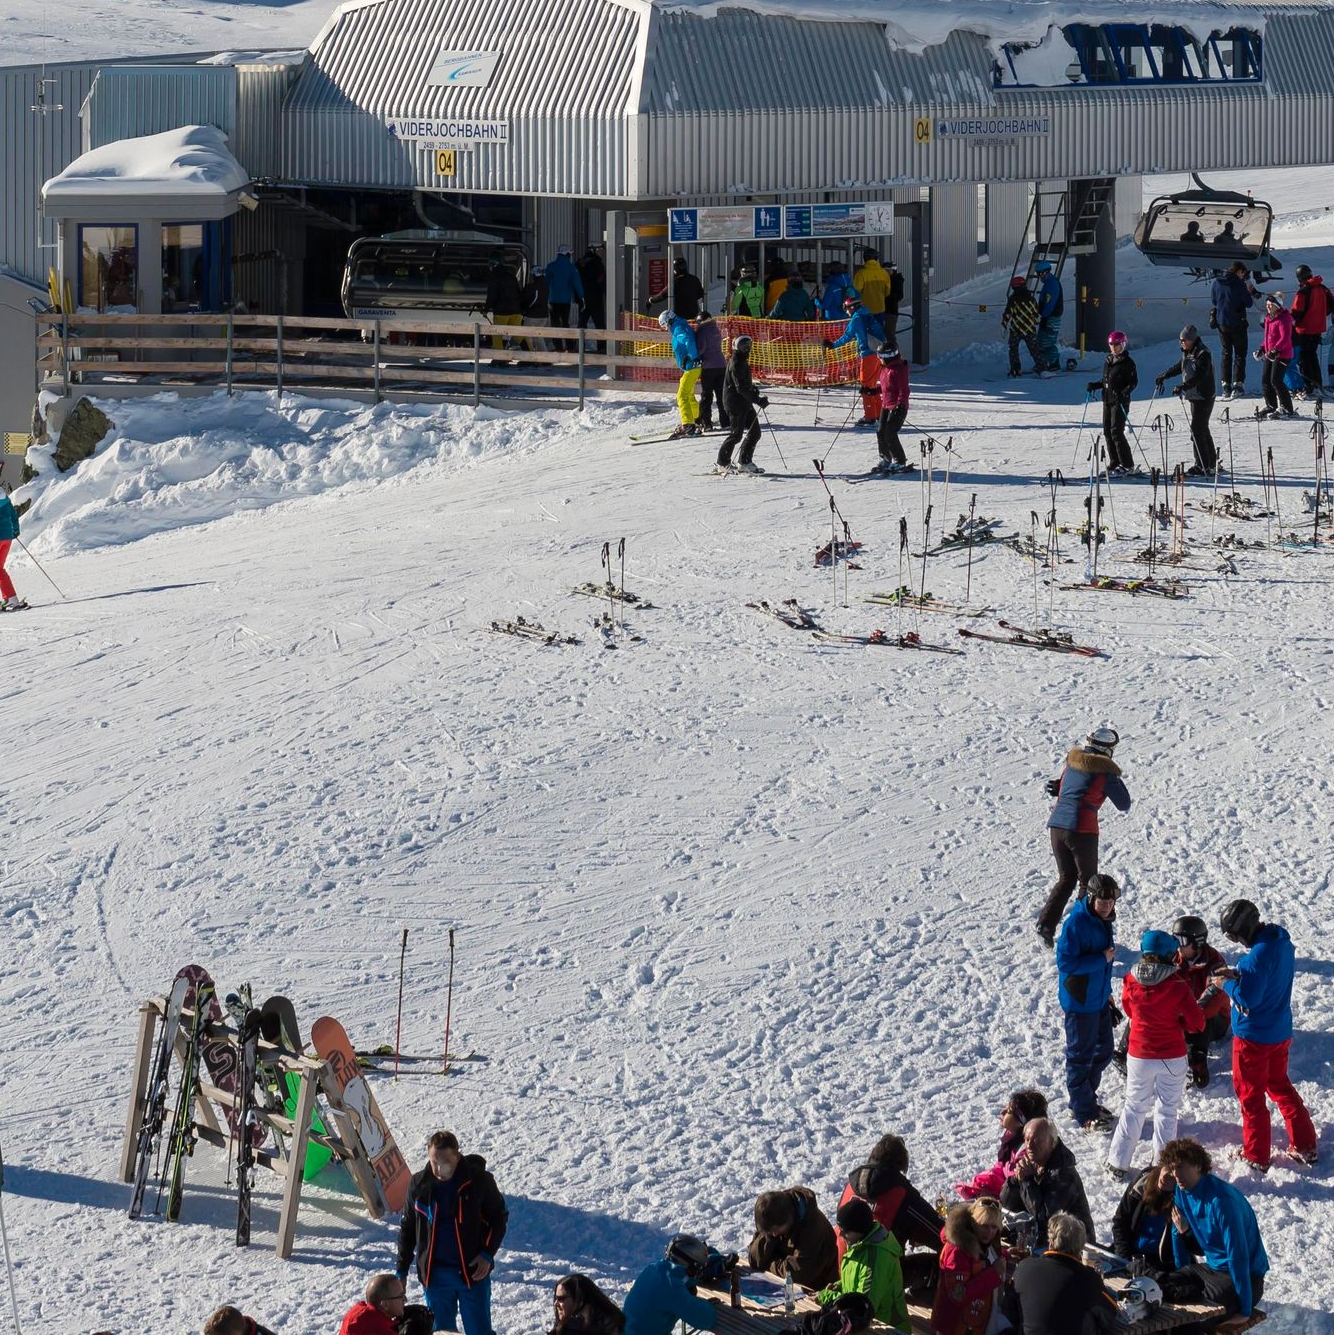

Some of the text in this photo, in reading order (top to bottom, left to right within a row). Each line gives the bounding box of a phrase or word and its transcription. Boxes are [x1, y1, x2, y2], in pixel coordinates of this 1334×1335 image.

[399, 121, 498, 139] VIDERJOCHBAHN
[916, 121, 929, 141] 04
[950, 119, 1041, 135] VIDERJOCHBAHN
[438, 152, 452, 173] 04
